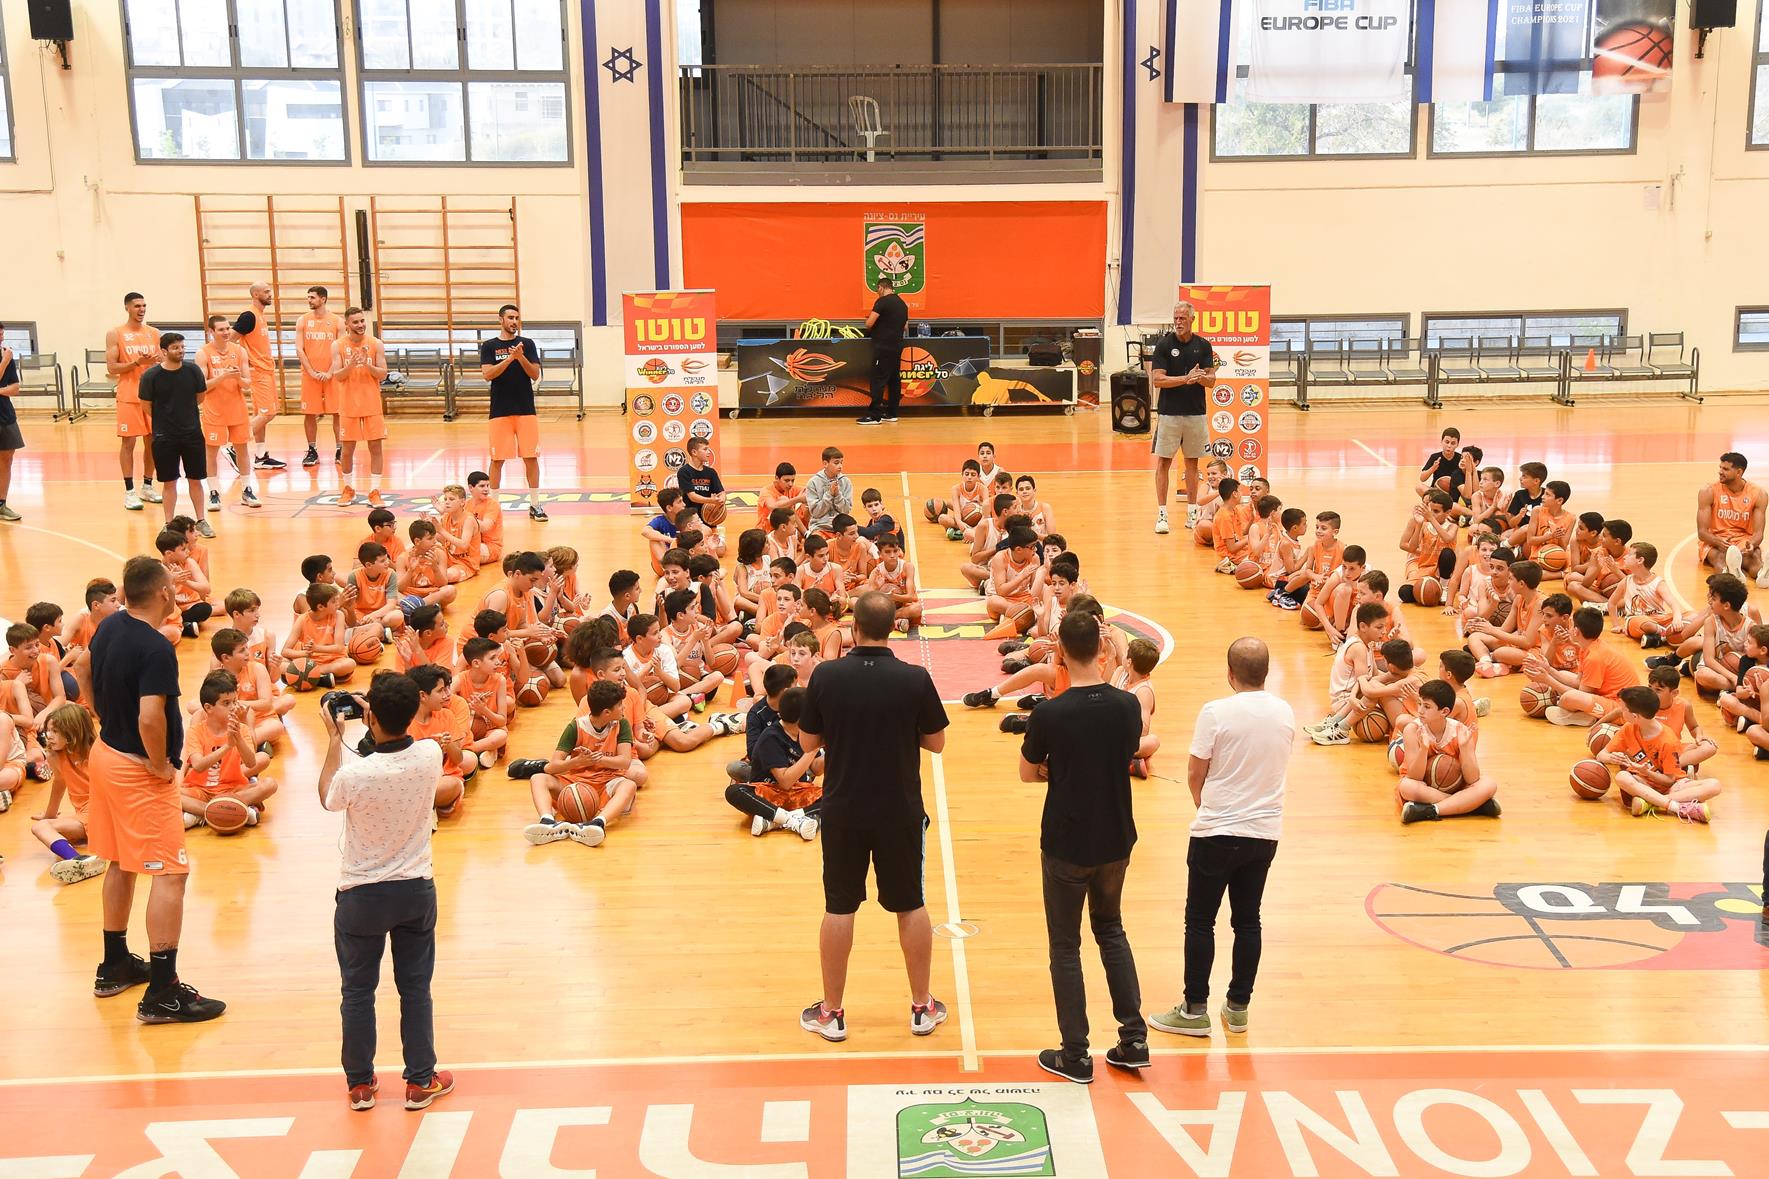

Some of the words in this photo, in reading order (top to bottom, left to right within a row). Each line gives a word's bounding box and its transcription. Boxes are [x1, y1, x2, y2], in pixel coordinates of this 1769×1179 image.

[1304, 0, 1354, 11] FIBA
[1511, 5, 1531, 13] FIBA
[1534, 3, 1563, 12] EUROPE
[1565, 3, 1582, 11] CUP
[1260, 16, 1348, 31] EUROPE
[1355, 16, 1397, 30] CUP
[900, 212, 926, 221] עיריית
[634, 317, 706, 342] טוטו
[637, 367, 667, 376] Winner
[913, 361, 934, 371] ליגת
[899, 370, 934, 379] nner
[934, 368, 949, 379] סל
[1216, 444, 1229, 455] NZ
[669, 455, 682, 466] NZ
[1516, 884, 1702, 925] סל
[895, 1088, 918, 1096] עיר
[922, 1088, 943, 1096] עם
[995, 1087, 1041, 1095] מושבה
